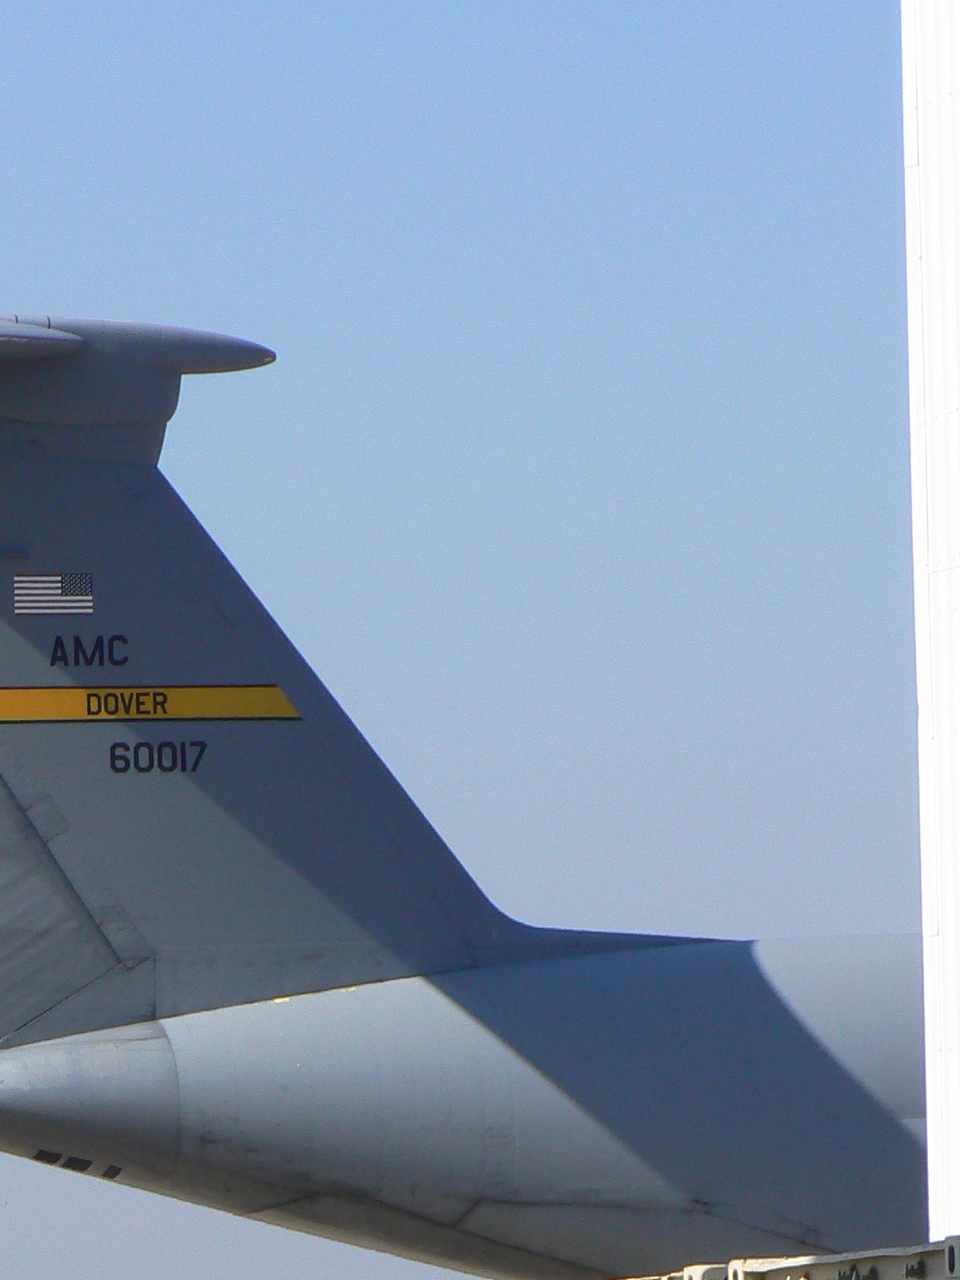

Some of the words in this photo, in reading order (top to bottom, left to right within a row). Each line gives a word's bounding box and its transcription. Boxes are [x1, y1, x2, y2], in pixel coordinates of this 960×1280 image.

[50, 635, 129, 666] AMC
[86, 691, 168, 716] DOVER
[109, 741, 207, 773] 60017
